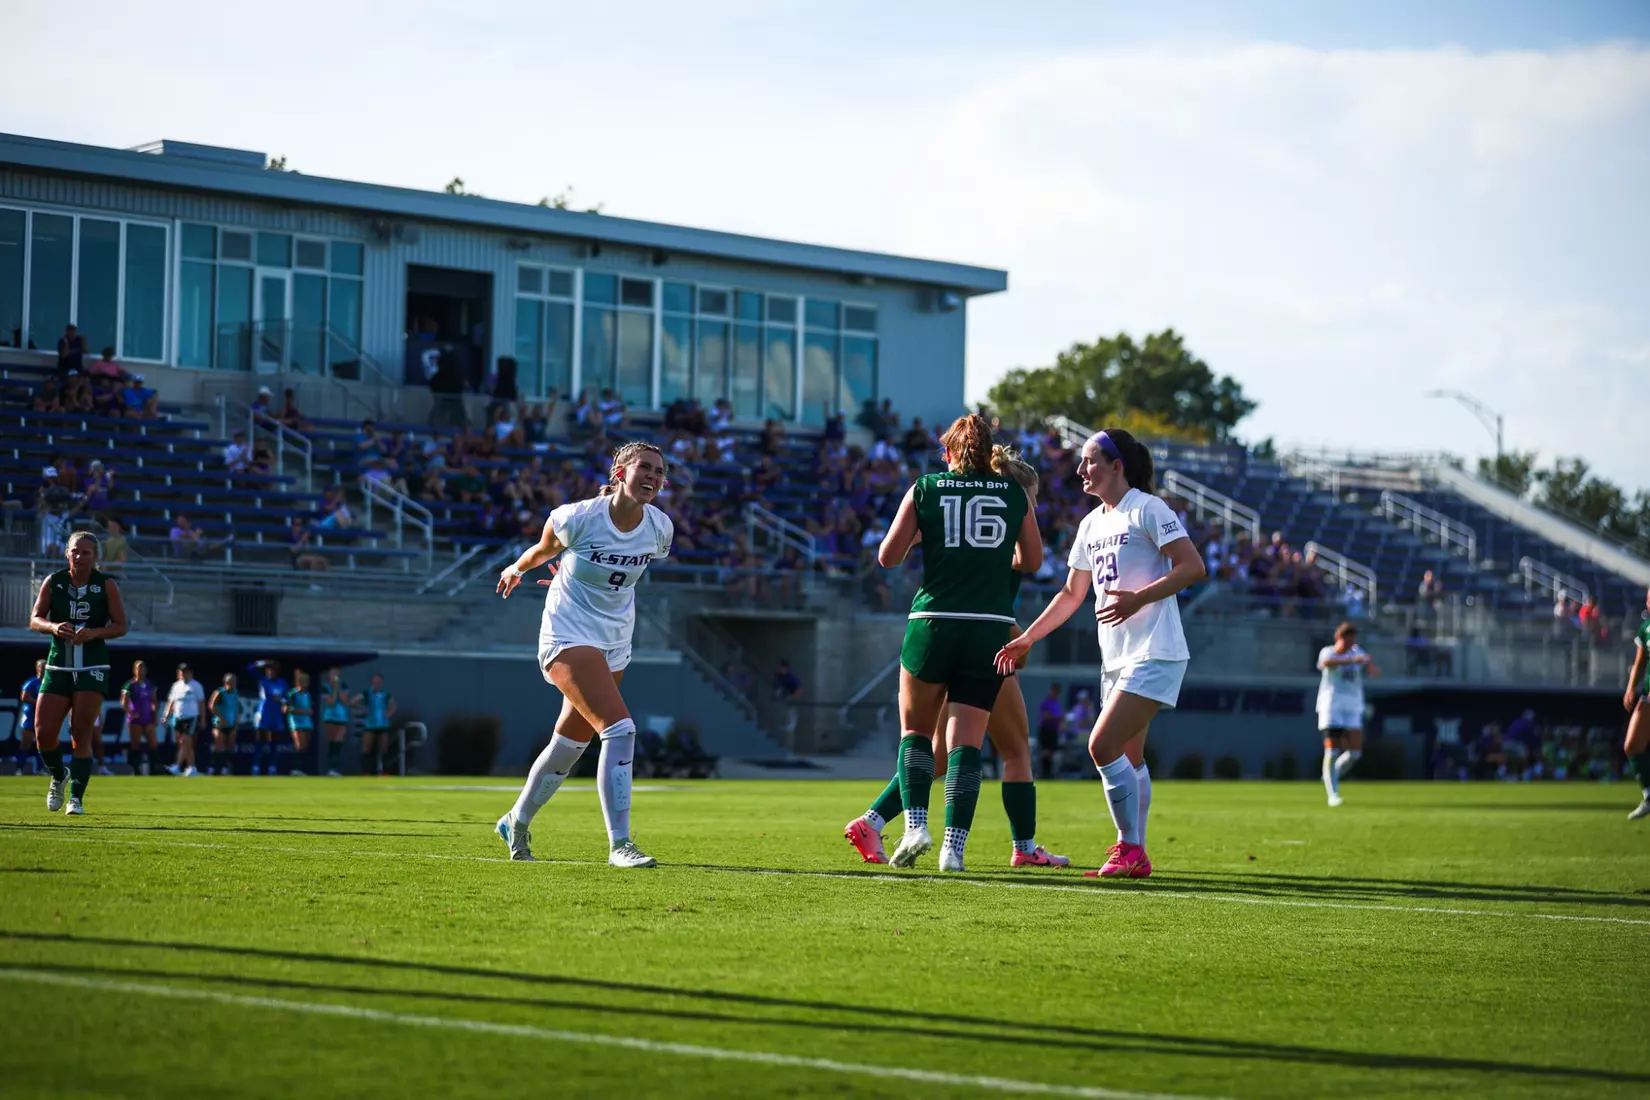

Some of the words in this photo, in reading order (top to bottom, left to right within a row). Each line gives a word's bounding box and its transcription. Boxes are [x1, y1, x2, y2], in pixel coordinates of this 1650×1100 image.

[936, 479, 984, 488] GREEN
[939, 494, 1008, 549] 16
[1095, 552, 1119, 585] 29
[608, 571, 628, 592] 9
[69, 600, 91, 620] 12
